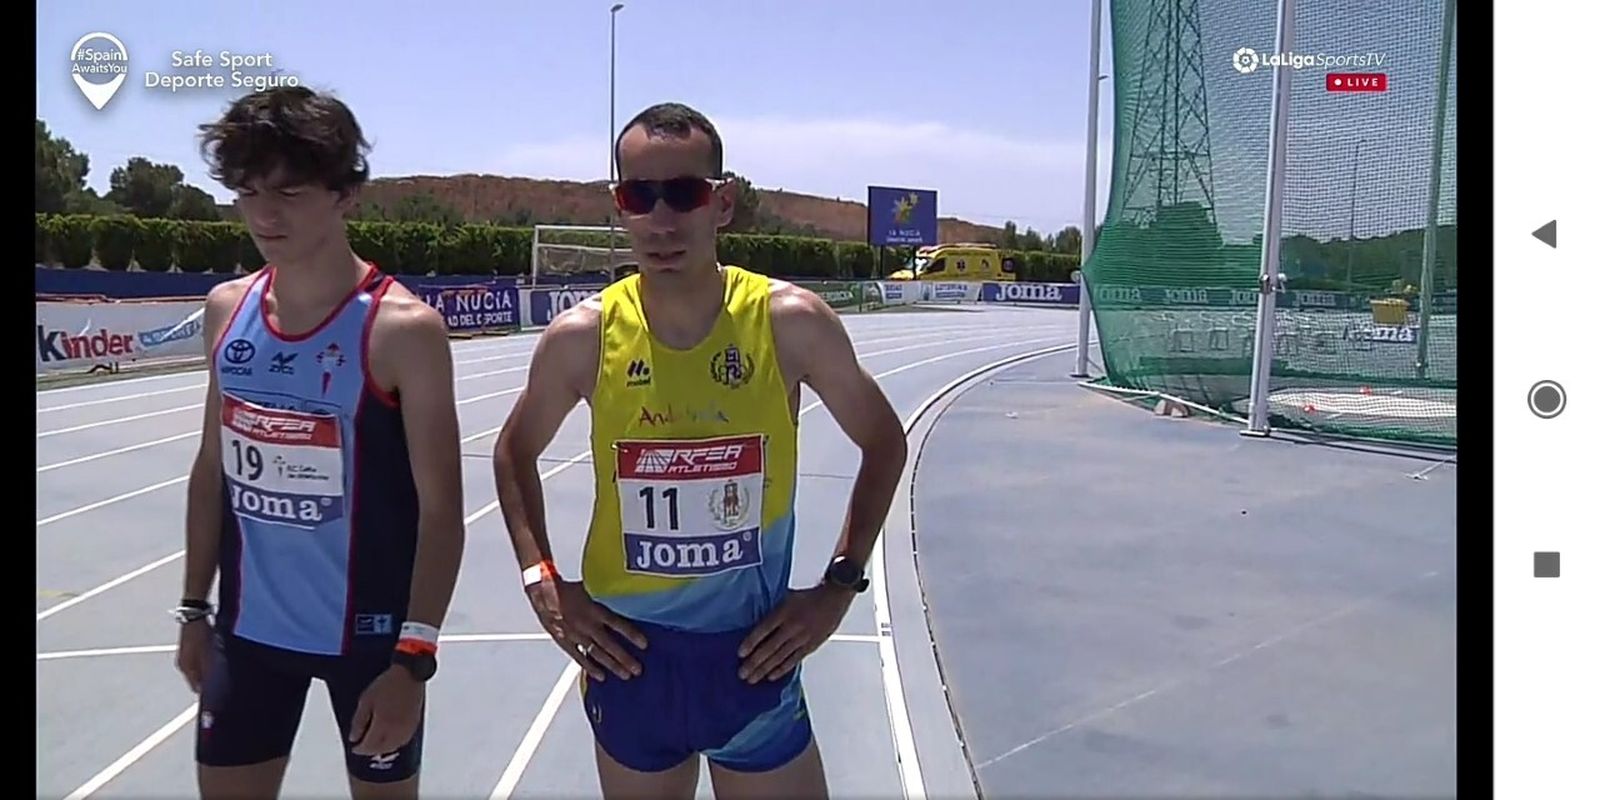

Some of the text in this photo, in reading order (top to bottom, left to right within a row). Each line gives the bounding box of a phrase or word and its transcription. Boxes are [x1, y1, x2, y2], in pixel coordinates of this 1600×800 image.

[232, 440, 263, 481] 19
[673, 444, 744, 464] RFEA
[639, 486, 679, 530] 11
